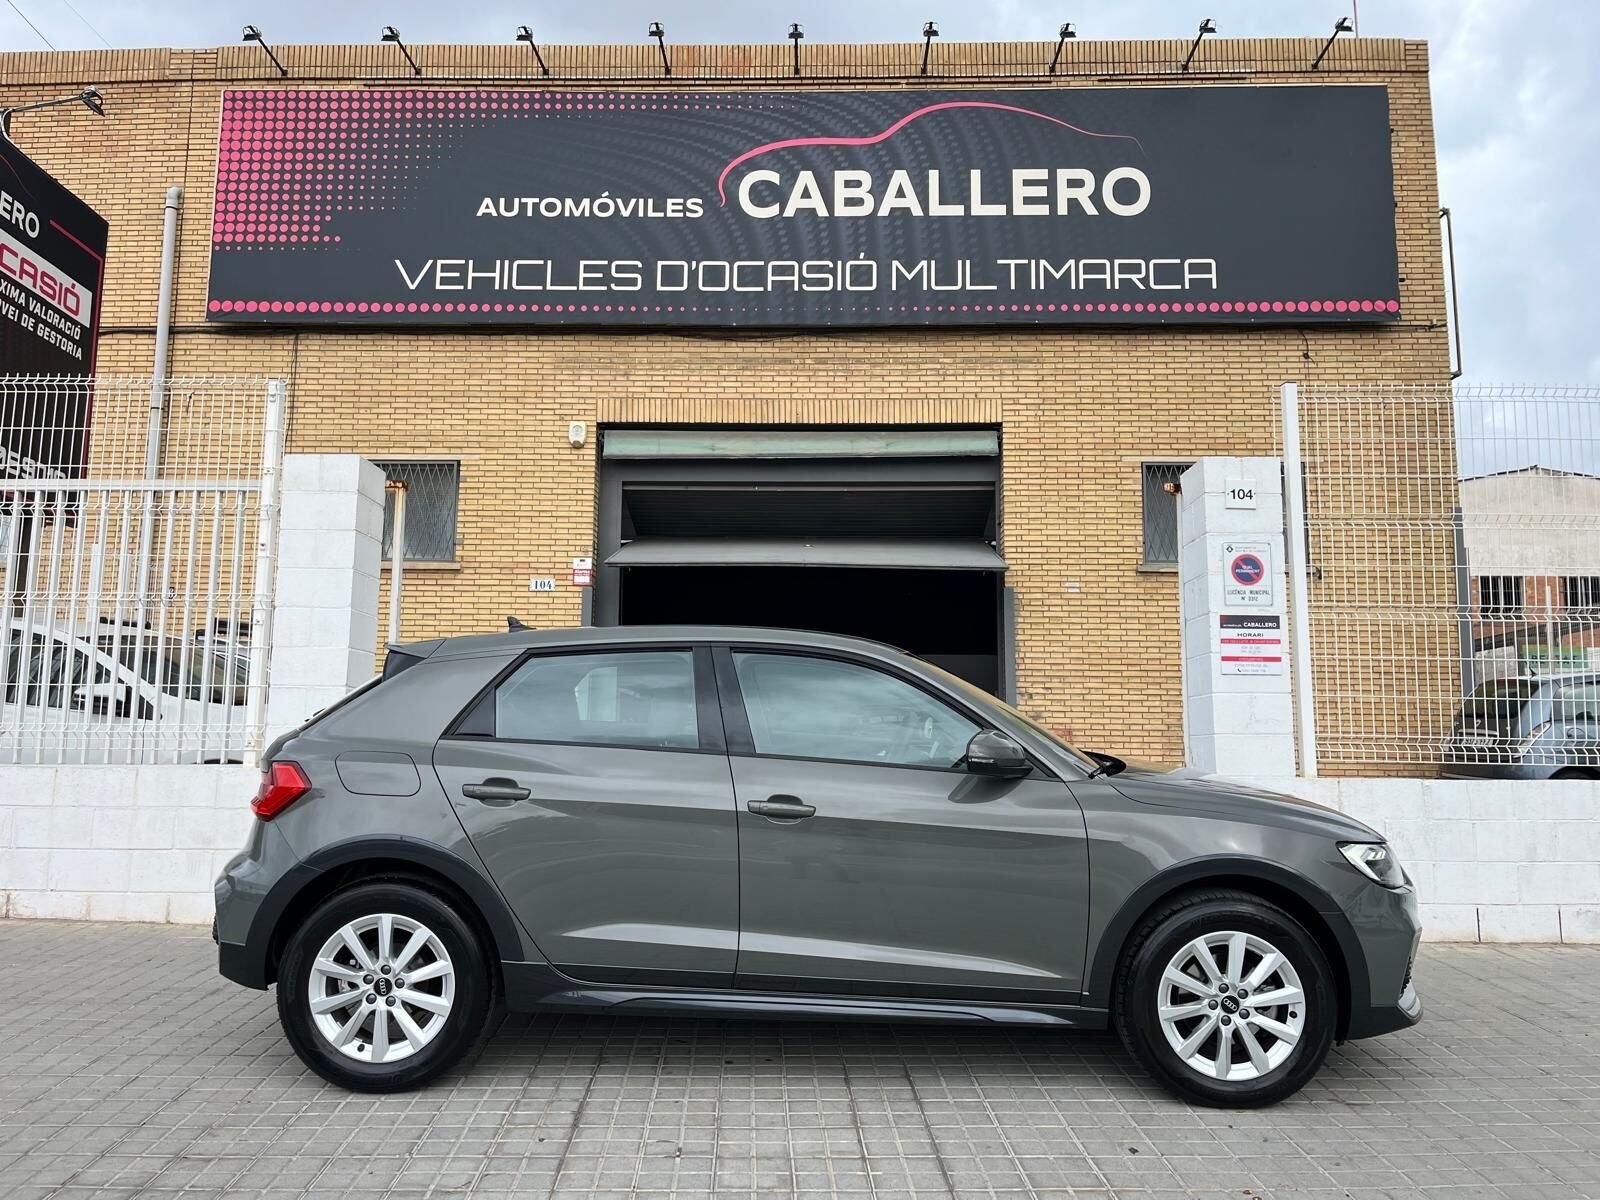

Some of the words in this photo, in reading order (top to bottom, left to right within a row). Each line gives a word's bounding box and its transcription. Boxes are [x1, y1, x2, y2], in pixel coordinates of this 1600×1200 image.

[476, 190, 704, 218] AUTOMÓVILES
[737, 166, 1152, 219] CABALLERO
[394, 258, 643, 290] VEHICLES
[656, 252, 878, 292] D'OCASIÓ
[891, 258, 1218, 291] MULTIMARCA
[21, 313, 36, 332] DE
[37, 323, 82, 361] GESTORIA
[29, 296, 81, 341] VALORACIÓ
[1230, 488, 1254, 500] 104
[534, 580, 552, 590] 104
